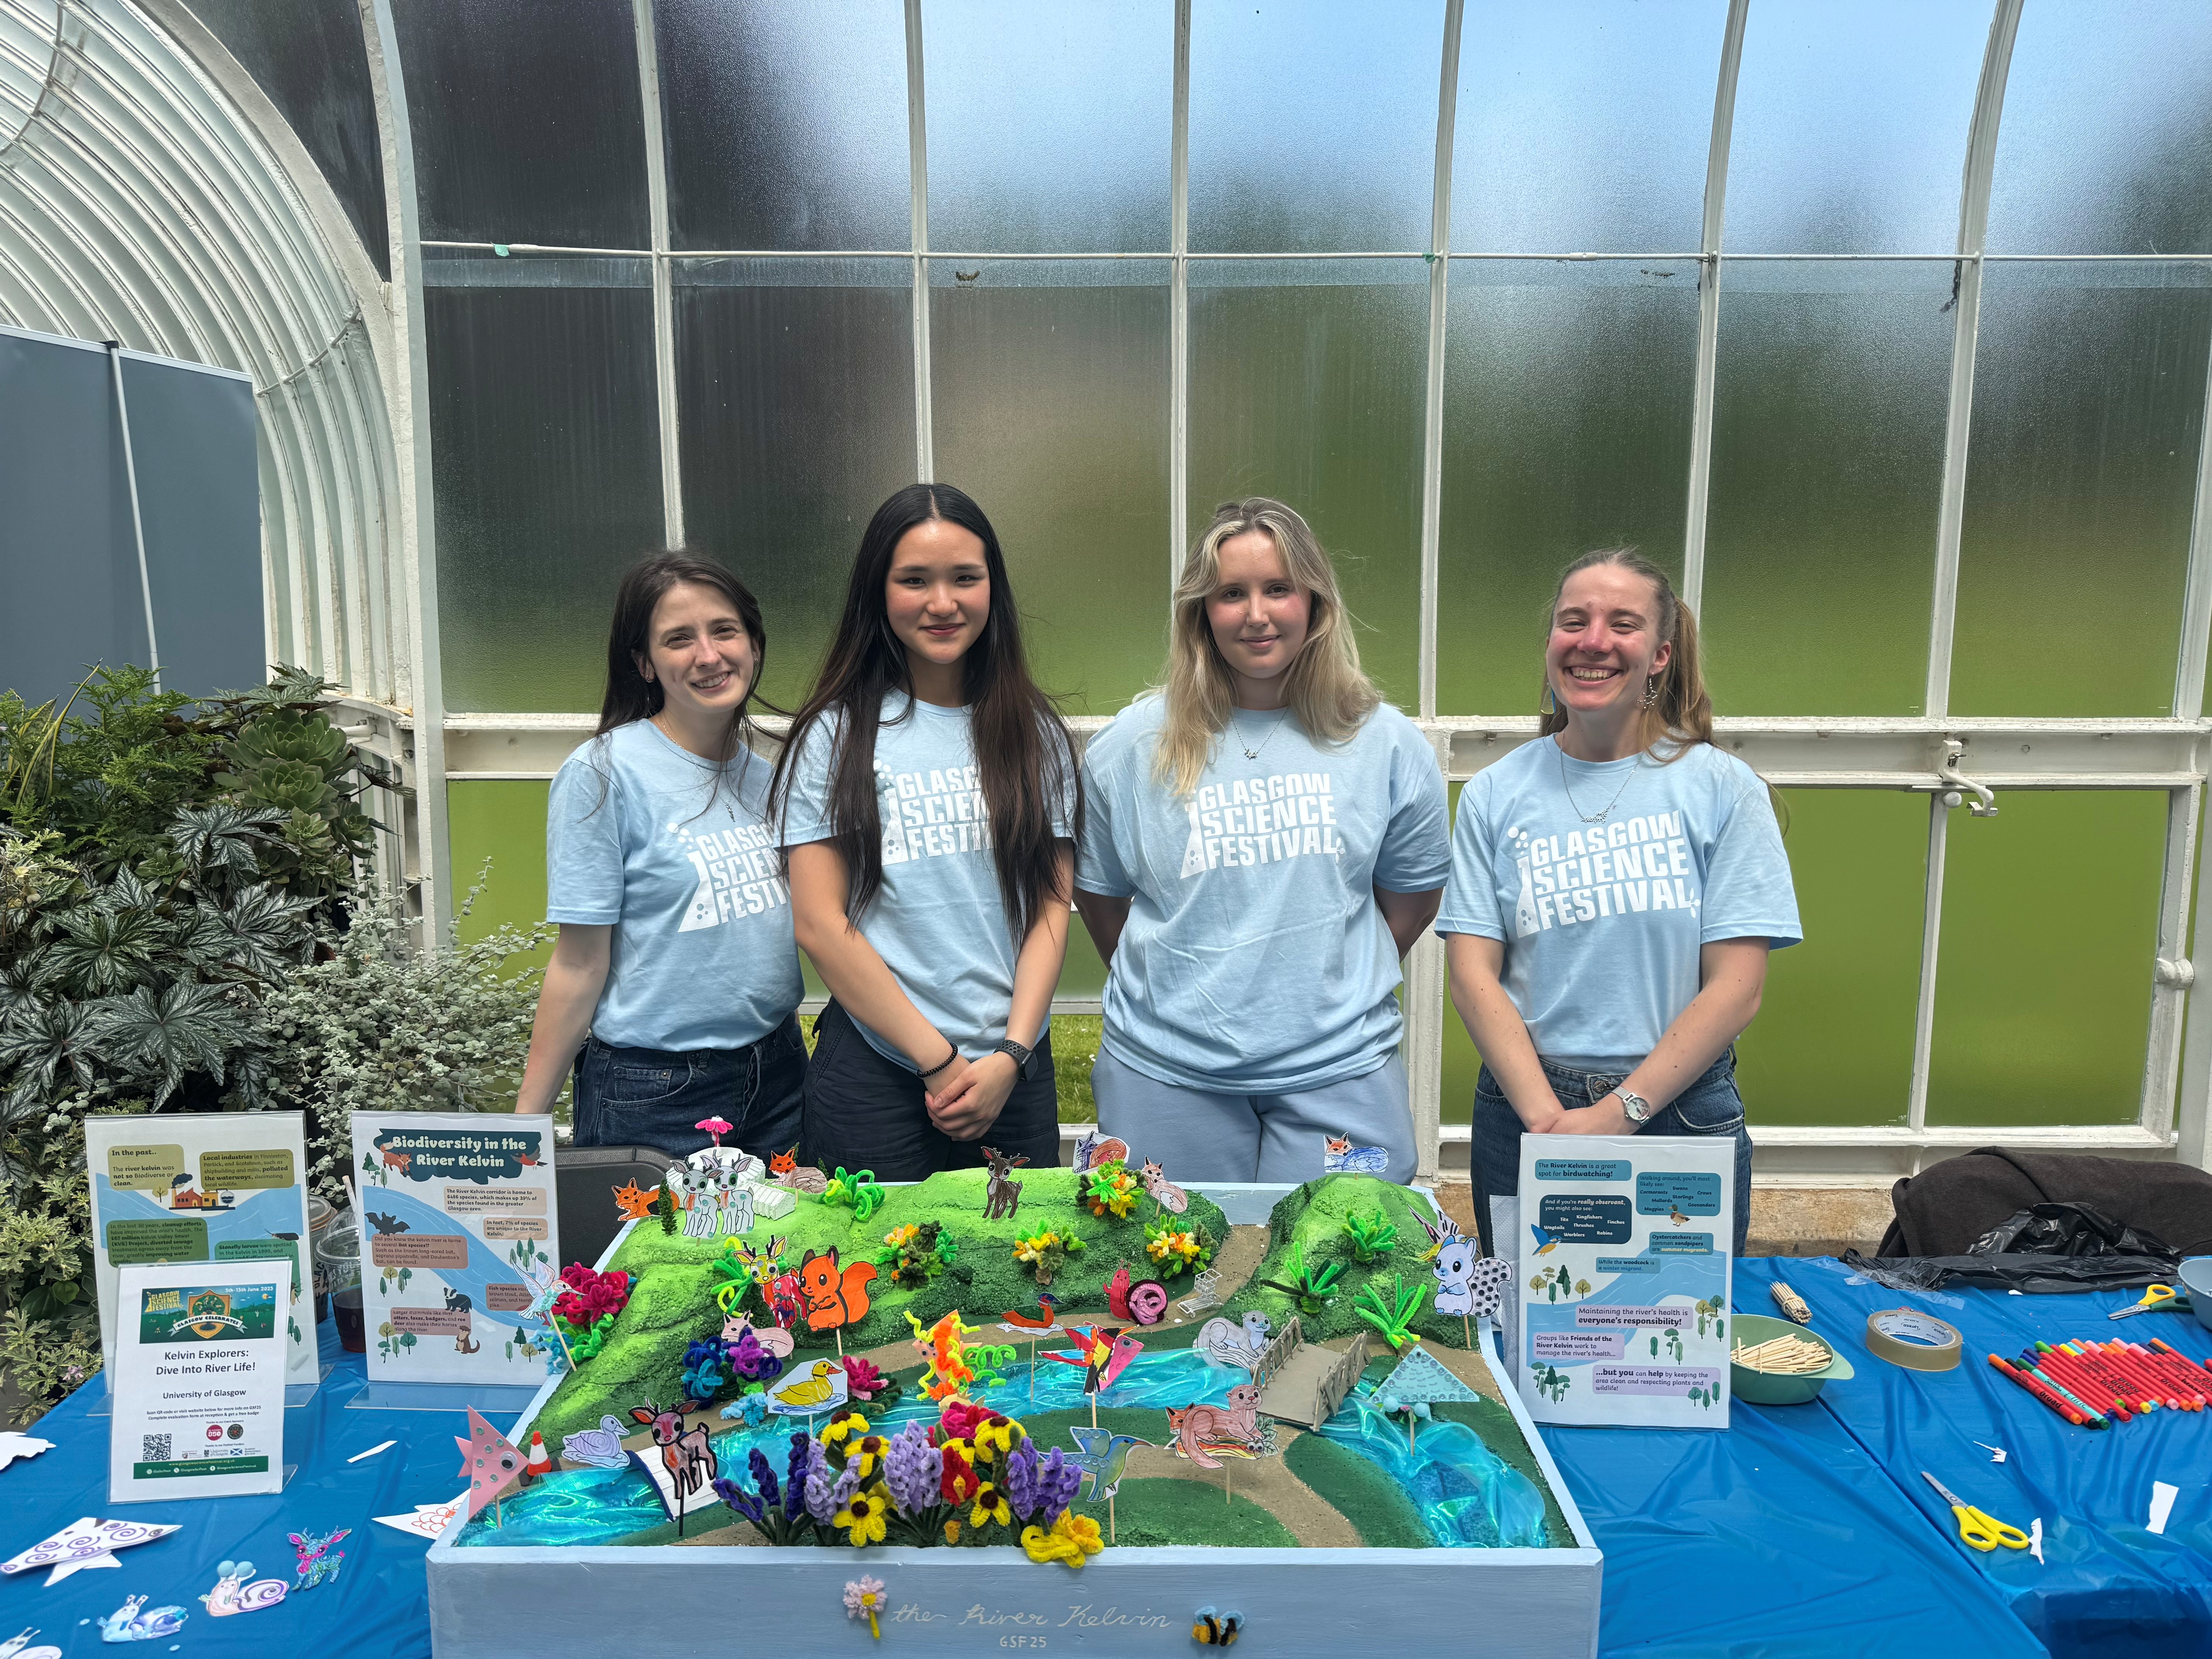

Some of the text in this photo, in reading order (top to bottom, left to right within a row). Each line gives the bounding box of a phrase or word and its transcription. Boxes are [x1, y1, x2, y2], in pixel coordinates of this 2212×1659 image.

[896, 766, 981, 799] GLASG
[1199, 773, 1330, 811] GLASGOW
[902, 790, 990, 827] SCIEN
[1201, 795, 1336, 837] SCIENCE
[696, 822, 774, 861] GLASG
[907, 822, 994, 860] FESTI
[1205, 827, 1338, 869] FESTIVAL
[1530, 810, 1680, 867] GLASGOW
[709, 848, 787, 890] SCIEN
[1533, 838, 1689, 895] SCIENCE
[716, 876, 789, 924] FESTI
[1537, 878, 1692, 930] FESTIVAL
[393, 1135, 526, 1152] Biodiversity in the
[417, 1154, 504, 1167] River Kelvin
[151, 1291, 179, 1300] GLASGOW
[152, 1295, 180, 1305] SCIENCE
[152, 1302, 180, 1311] FESTIVAL
[178, 1316, 239, 1327] GLASGOW CELEBRATES
[1624, 1317, 1681, 1326] responsibility!
[156, 1366, 179, 1375] Dive
[205, 1364, 231, 1372] River
[234, 1362, 255, 1371] Life!
[165, 1349, 249, 1360] Kelvin Explorers:
[891, 1603, 1172, 1627] the River Kelvin
